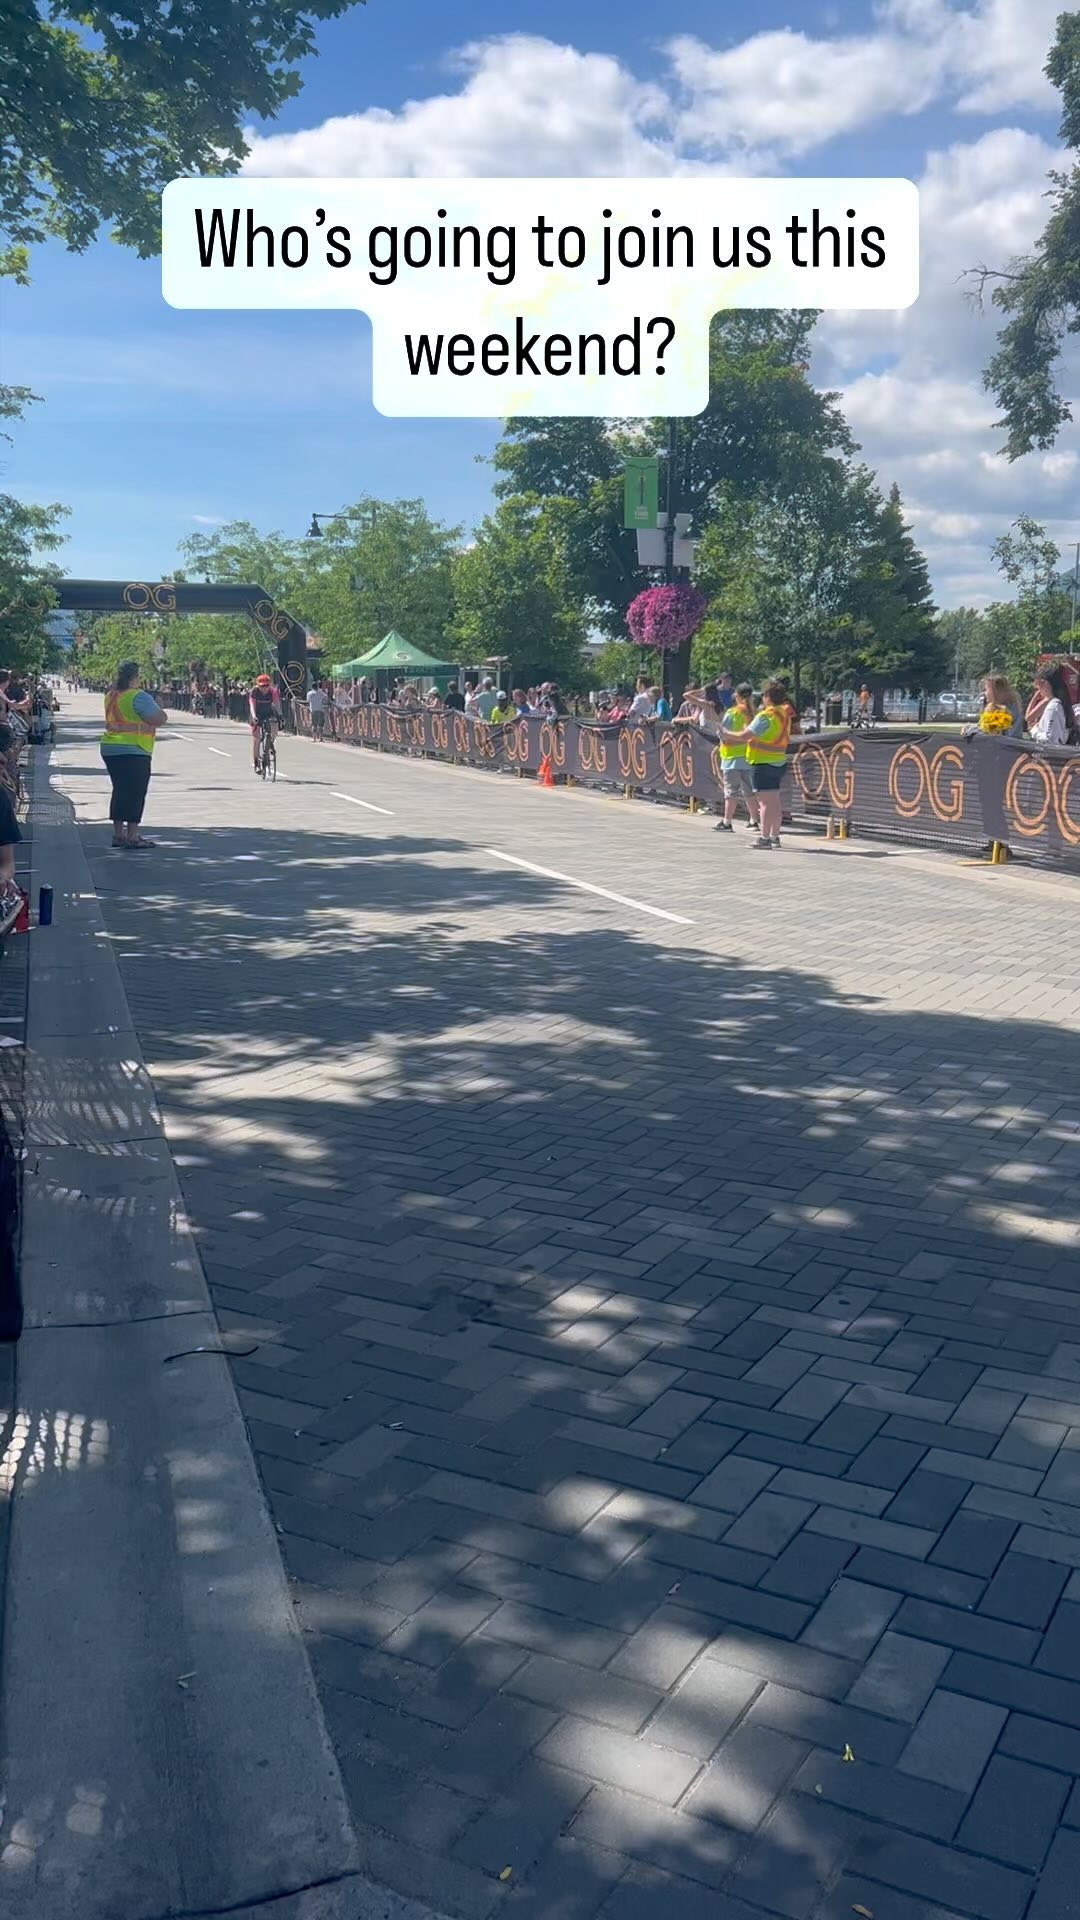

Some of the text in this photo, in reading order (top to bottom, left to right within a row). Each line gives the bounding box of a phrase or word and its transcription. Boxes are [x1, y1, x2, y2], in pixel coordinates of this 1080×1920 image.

[123, 583, 176, 610] OG
[254, 600, 294, 639] OG
[503, 720, 528, 762] OG
[578, 727, 606, 772] OG
[618, 727, 647, 779] OG
[660, 731, 694, 787] OG
[792, 740, 854, 809] OG
[888, 743, 964, 822] OG
